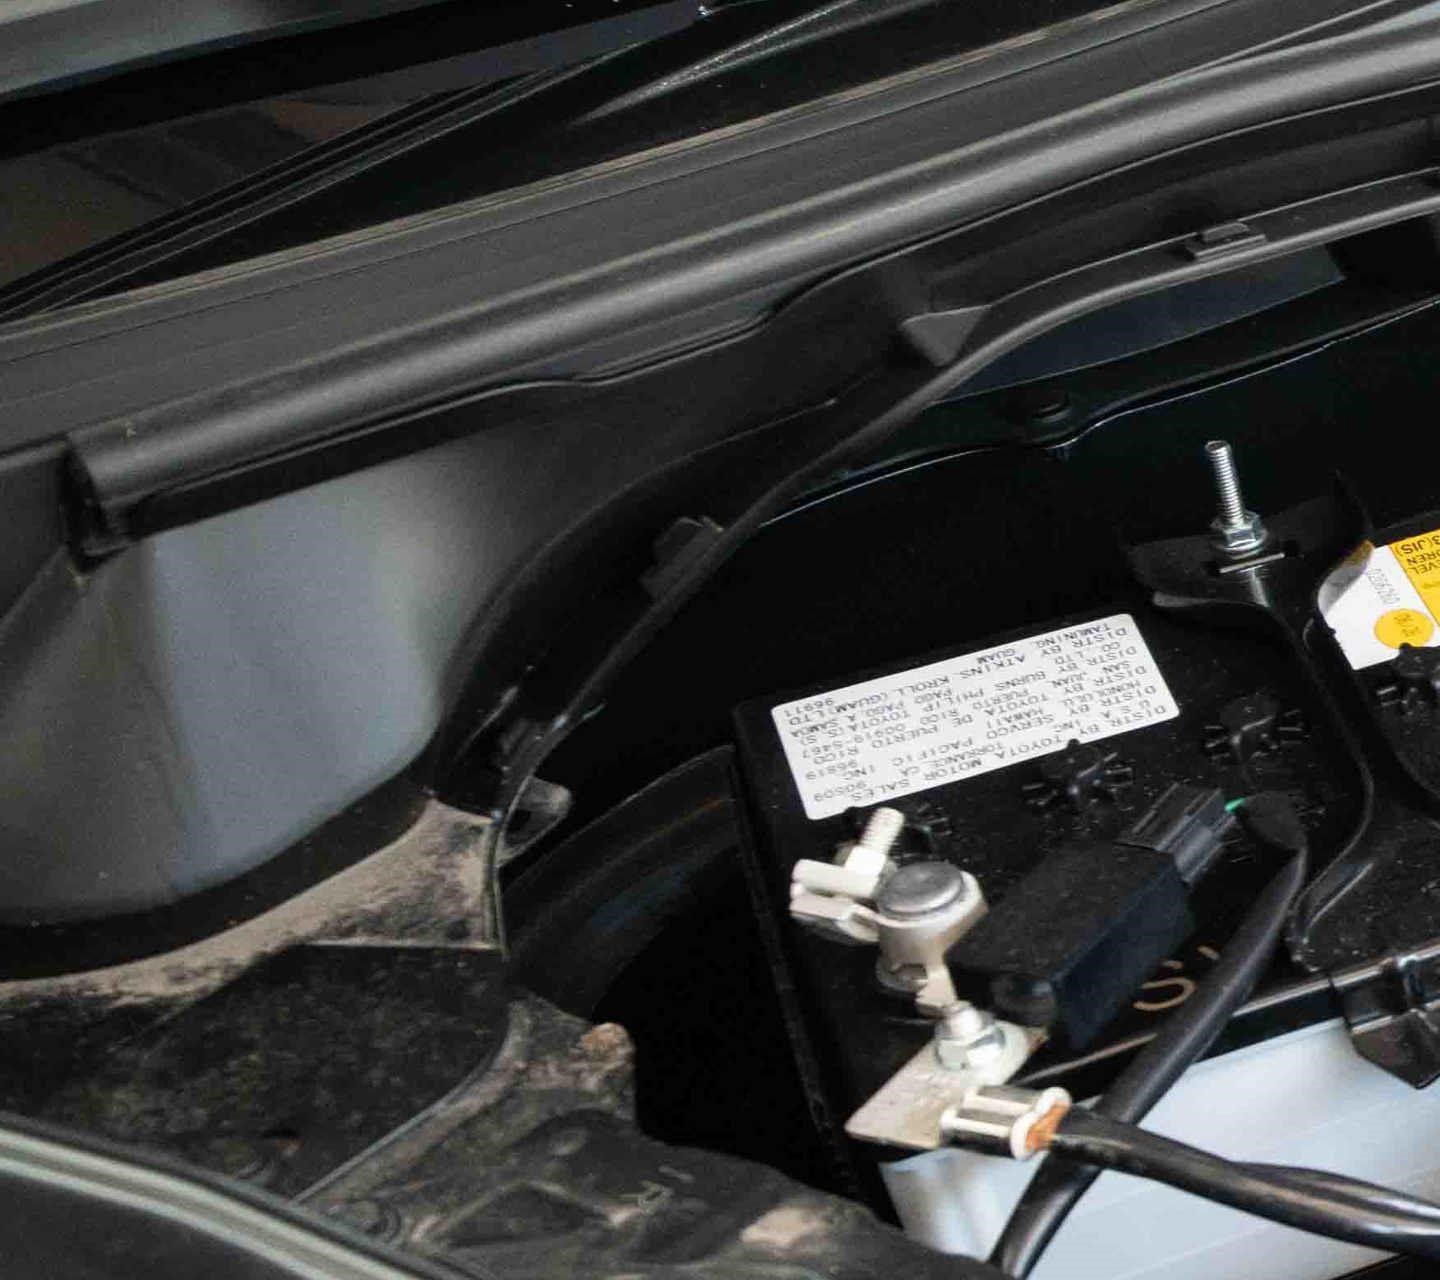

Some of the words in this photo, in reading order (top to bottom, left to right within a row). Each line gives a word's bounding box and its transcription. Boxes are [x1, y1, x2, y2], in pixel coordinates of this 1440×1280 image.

[975, 647, 1016, 664] GUAM
[1101, 660, 1131, 674] SAN
[893, 675, 949, 697] KROLL
[992, 670, 1046, 691] BURNS
[912, 687, 952, 704] PAGO
[921, 687, 984, 712] PHILIP
[970, 688, 1029, 710] PUERTO
[982, 692, 1048, 717] TOYOTA
[918, 708, 958, 725] RICO
[985, 706, 1043, 729] HAWAII
[869, 723, 938, 749] PUERTO
[994, 734, 1062, 760] TOYOTA
[812, 745, 859, 765] RICO
[890, 736, 973, 767] PACIFIC
[922, 757, 982, 781] MOTOR
